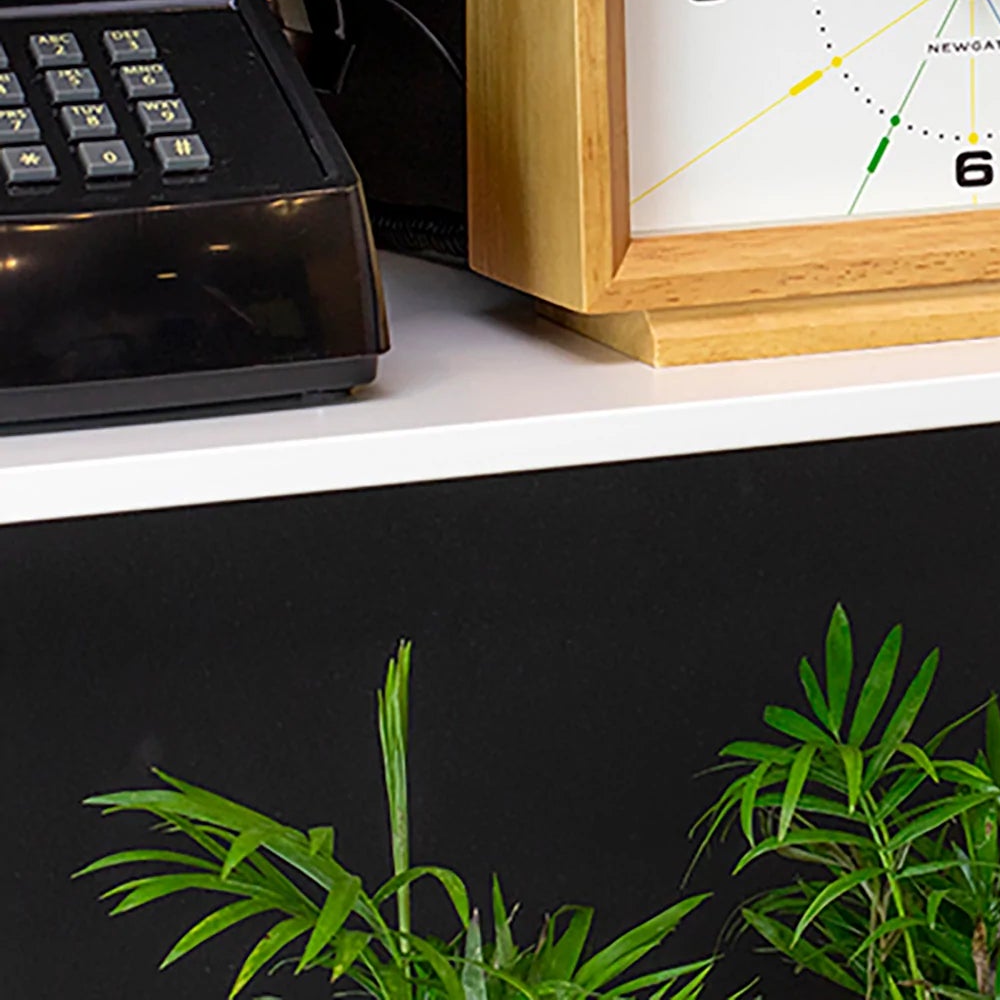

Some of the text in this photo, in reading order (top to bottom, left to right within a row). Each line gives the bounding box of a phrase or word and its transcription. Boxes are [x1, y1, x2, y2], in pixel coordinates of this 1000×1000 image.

[142, 74, 156, 86] 6
[71, 104, 104, 116] TUV
[160, 110, 175, 122] 9
[10, 120, 22, 132] 7
[955, 150, 994, 188] 6
